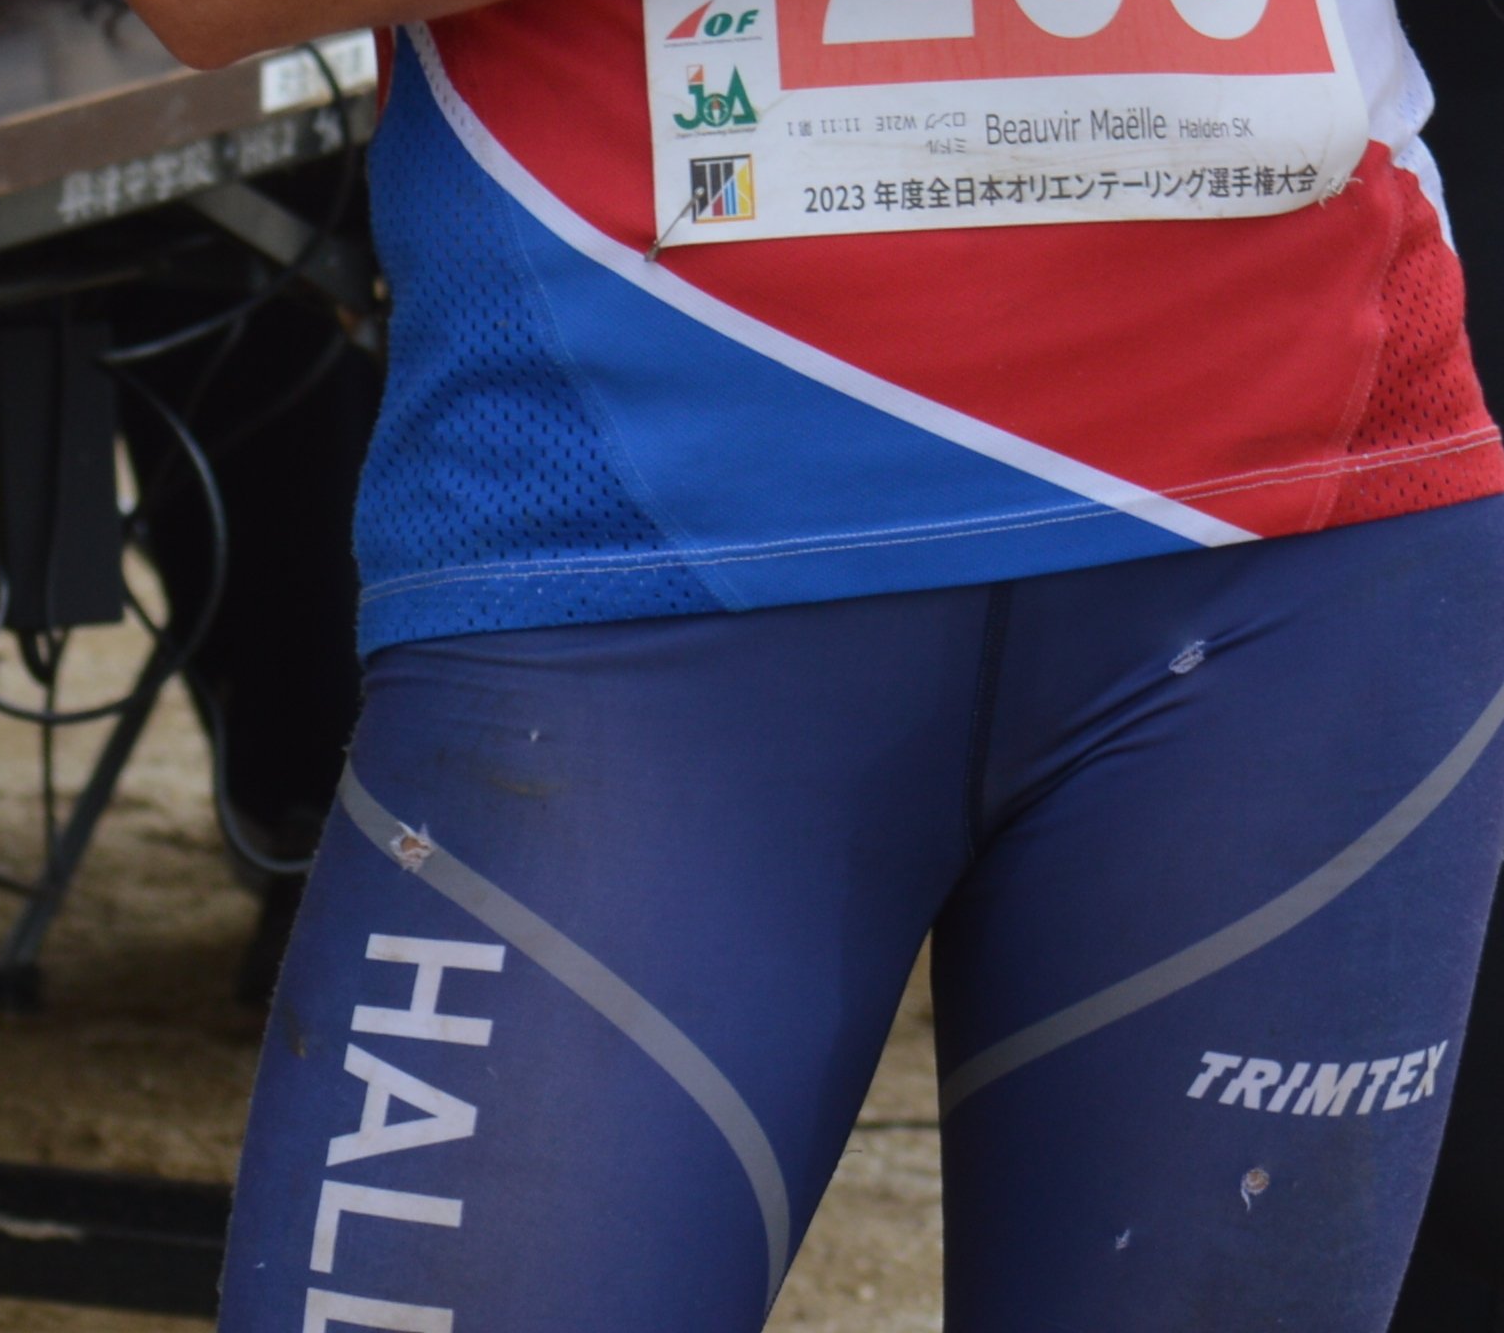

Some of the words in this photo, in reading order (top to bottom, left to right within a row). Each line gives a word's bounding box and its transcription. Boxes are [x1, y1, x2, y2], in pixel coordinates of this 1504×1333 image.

[985, 110, 1081, 146] Beauvir
[1090, 107, 1168, 142] Maëlle
[1178, 116, 1231, 139] Halden
[1233, 117, 1256, 137] SK
[804, 183, 866, 214] 2023
[873, 163, 1319, 214] 年度全日本オリエンテーリング選手権大会
[1186, 1039, 1450, 1118] TRIMTEX
